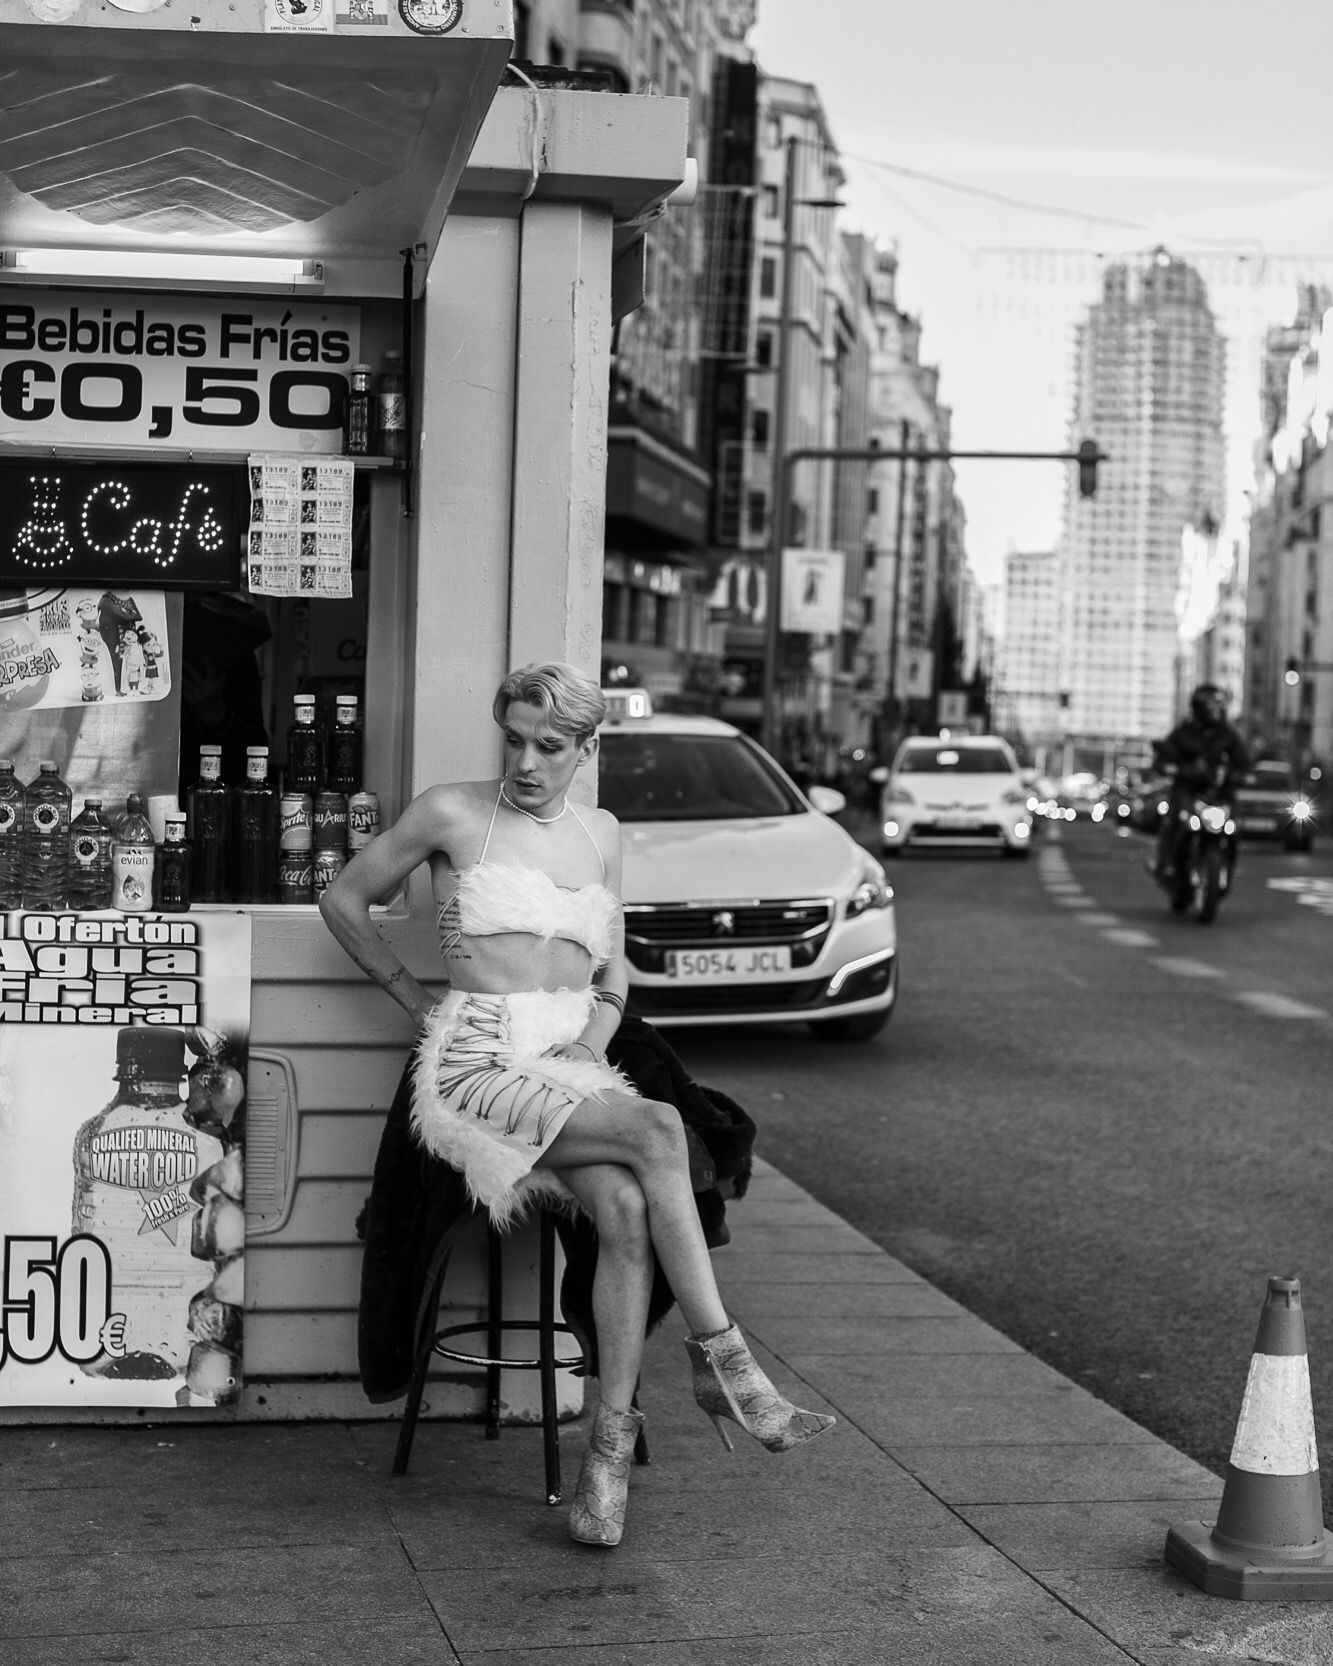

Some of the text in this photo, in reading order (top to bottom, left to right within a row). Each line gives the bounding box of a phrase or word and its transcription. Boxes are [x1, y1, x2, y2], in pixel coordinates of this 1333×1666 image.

[0, 304, 351, 364] Bebidas Frías
[82, 480, 223, 567] Café
[120, 853, 148, 865] evian
[21, 914, 199, 945] Ofertón
[682, 953, 737, 976] 5054
[748, 951, 785, 974] JCL
[91, 1128, 196, 1153] QUALIFED MINERAL
[91, 1150, 197, 1189] WATER COLD
[142, 1186, 187, 1222] 100%
